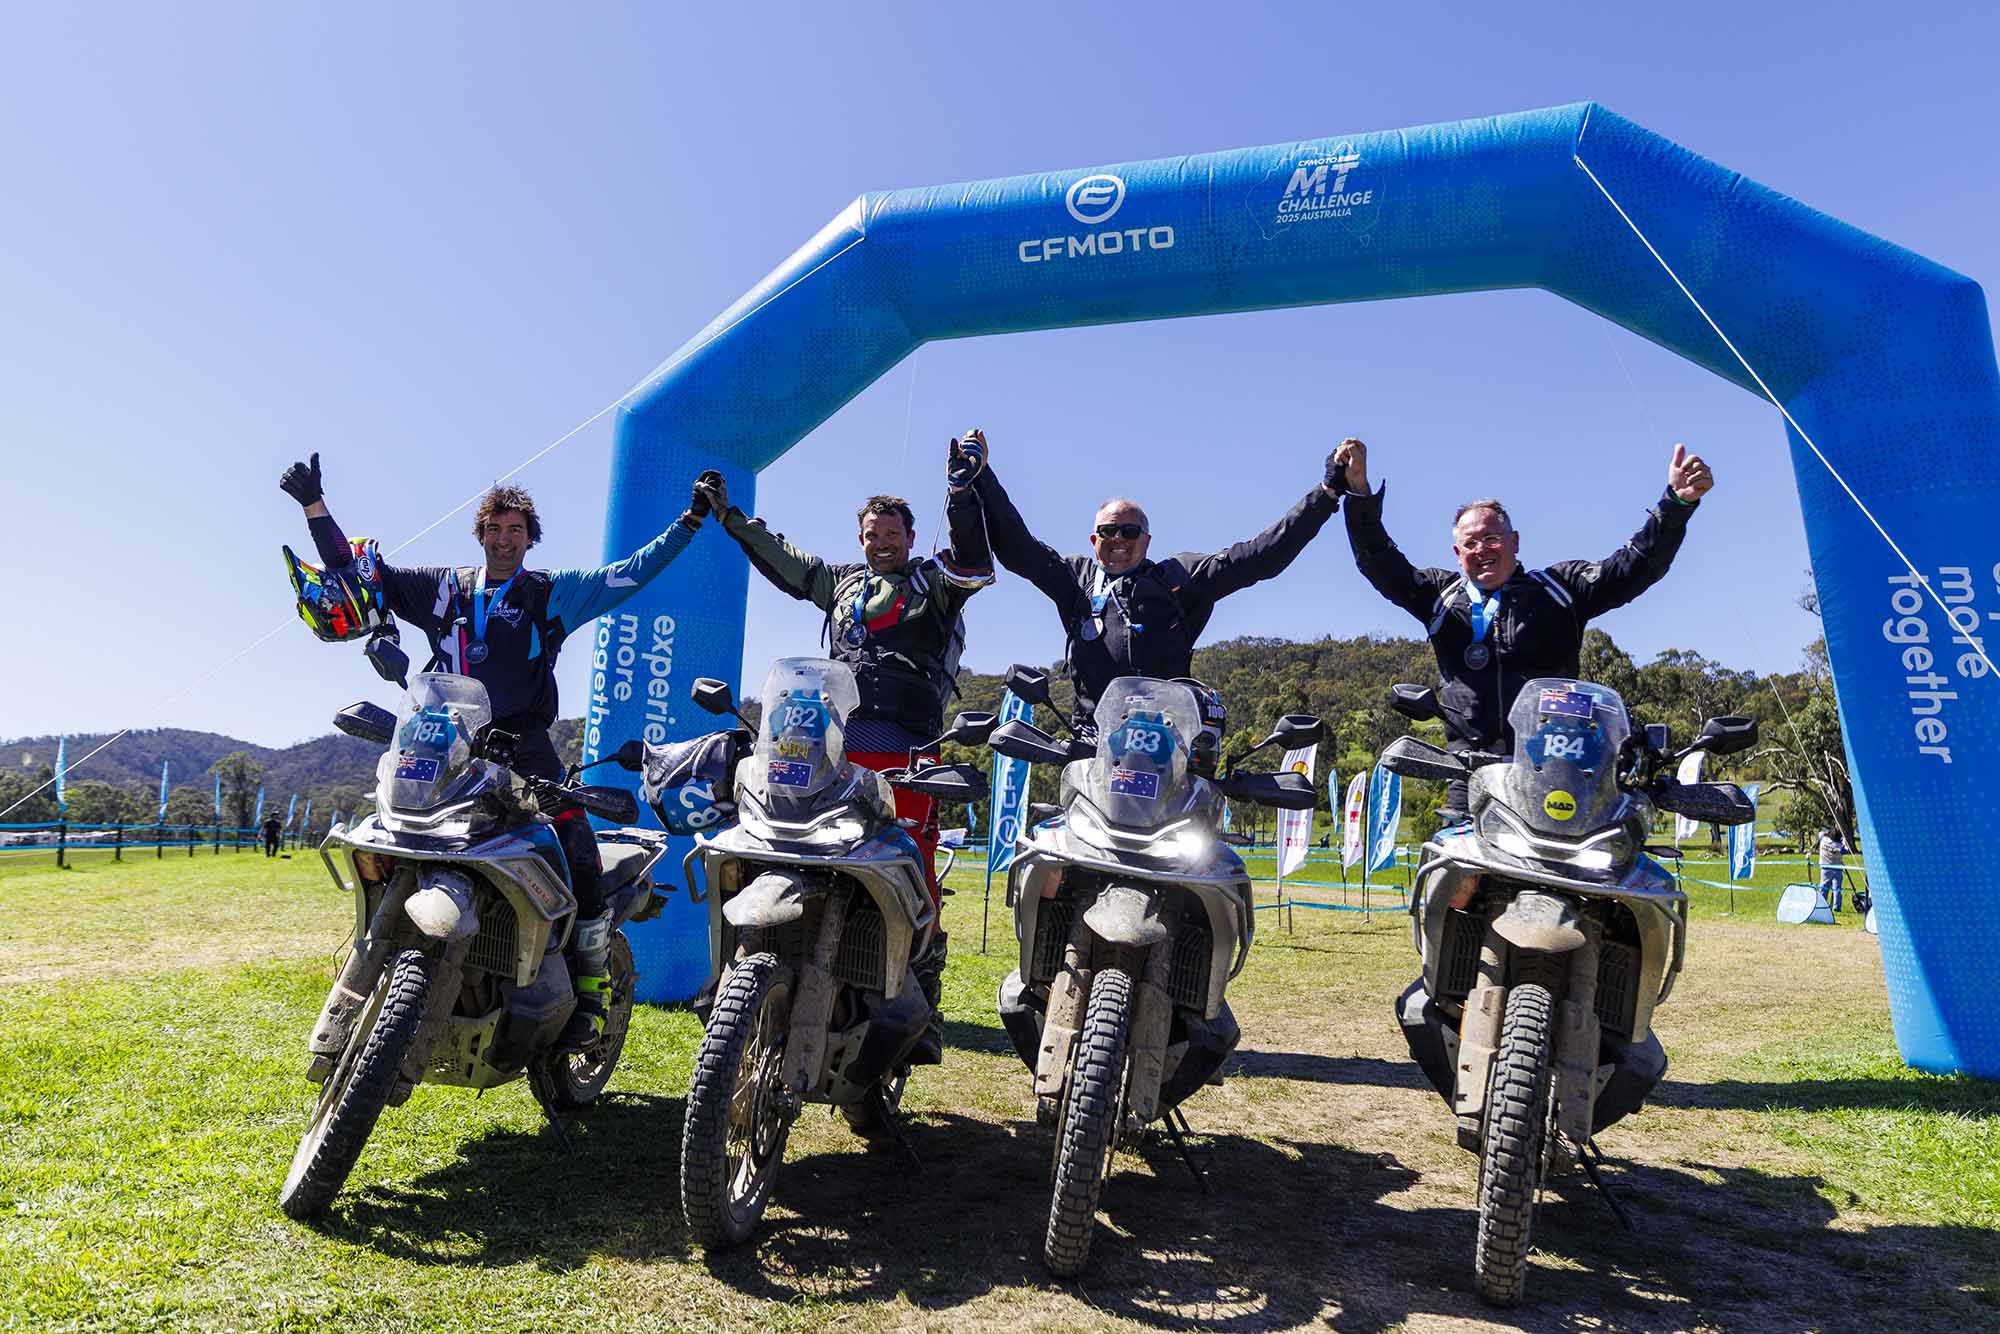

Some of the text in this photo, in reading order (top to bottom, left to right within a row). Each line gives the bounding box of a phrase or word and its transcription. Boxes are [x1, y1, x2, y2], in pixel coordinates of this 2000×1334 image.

[1283, 162, 1360, 199] MT
[1275, 208, 1352, 224] 2025 AUSTRALIA
[1278, 191, 1373, 213] CHALLENGE
[1018, 226, 1175, 263] CFMOTO
[1938, 566, 1989, 679] more
[613, 614, 639, 702] more
[1882, 570, 1958, 764] together
[587, 614, 616, 763] together
[641, 615, 677, 743] experie
[784, 705, 818, 728] 182
[1124, 728, 1160, 752] 183
[1543, 734, 1585, 759] 184
